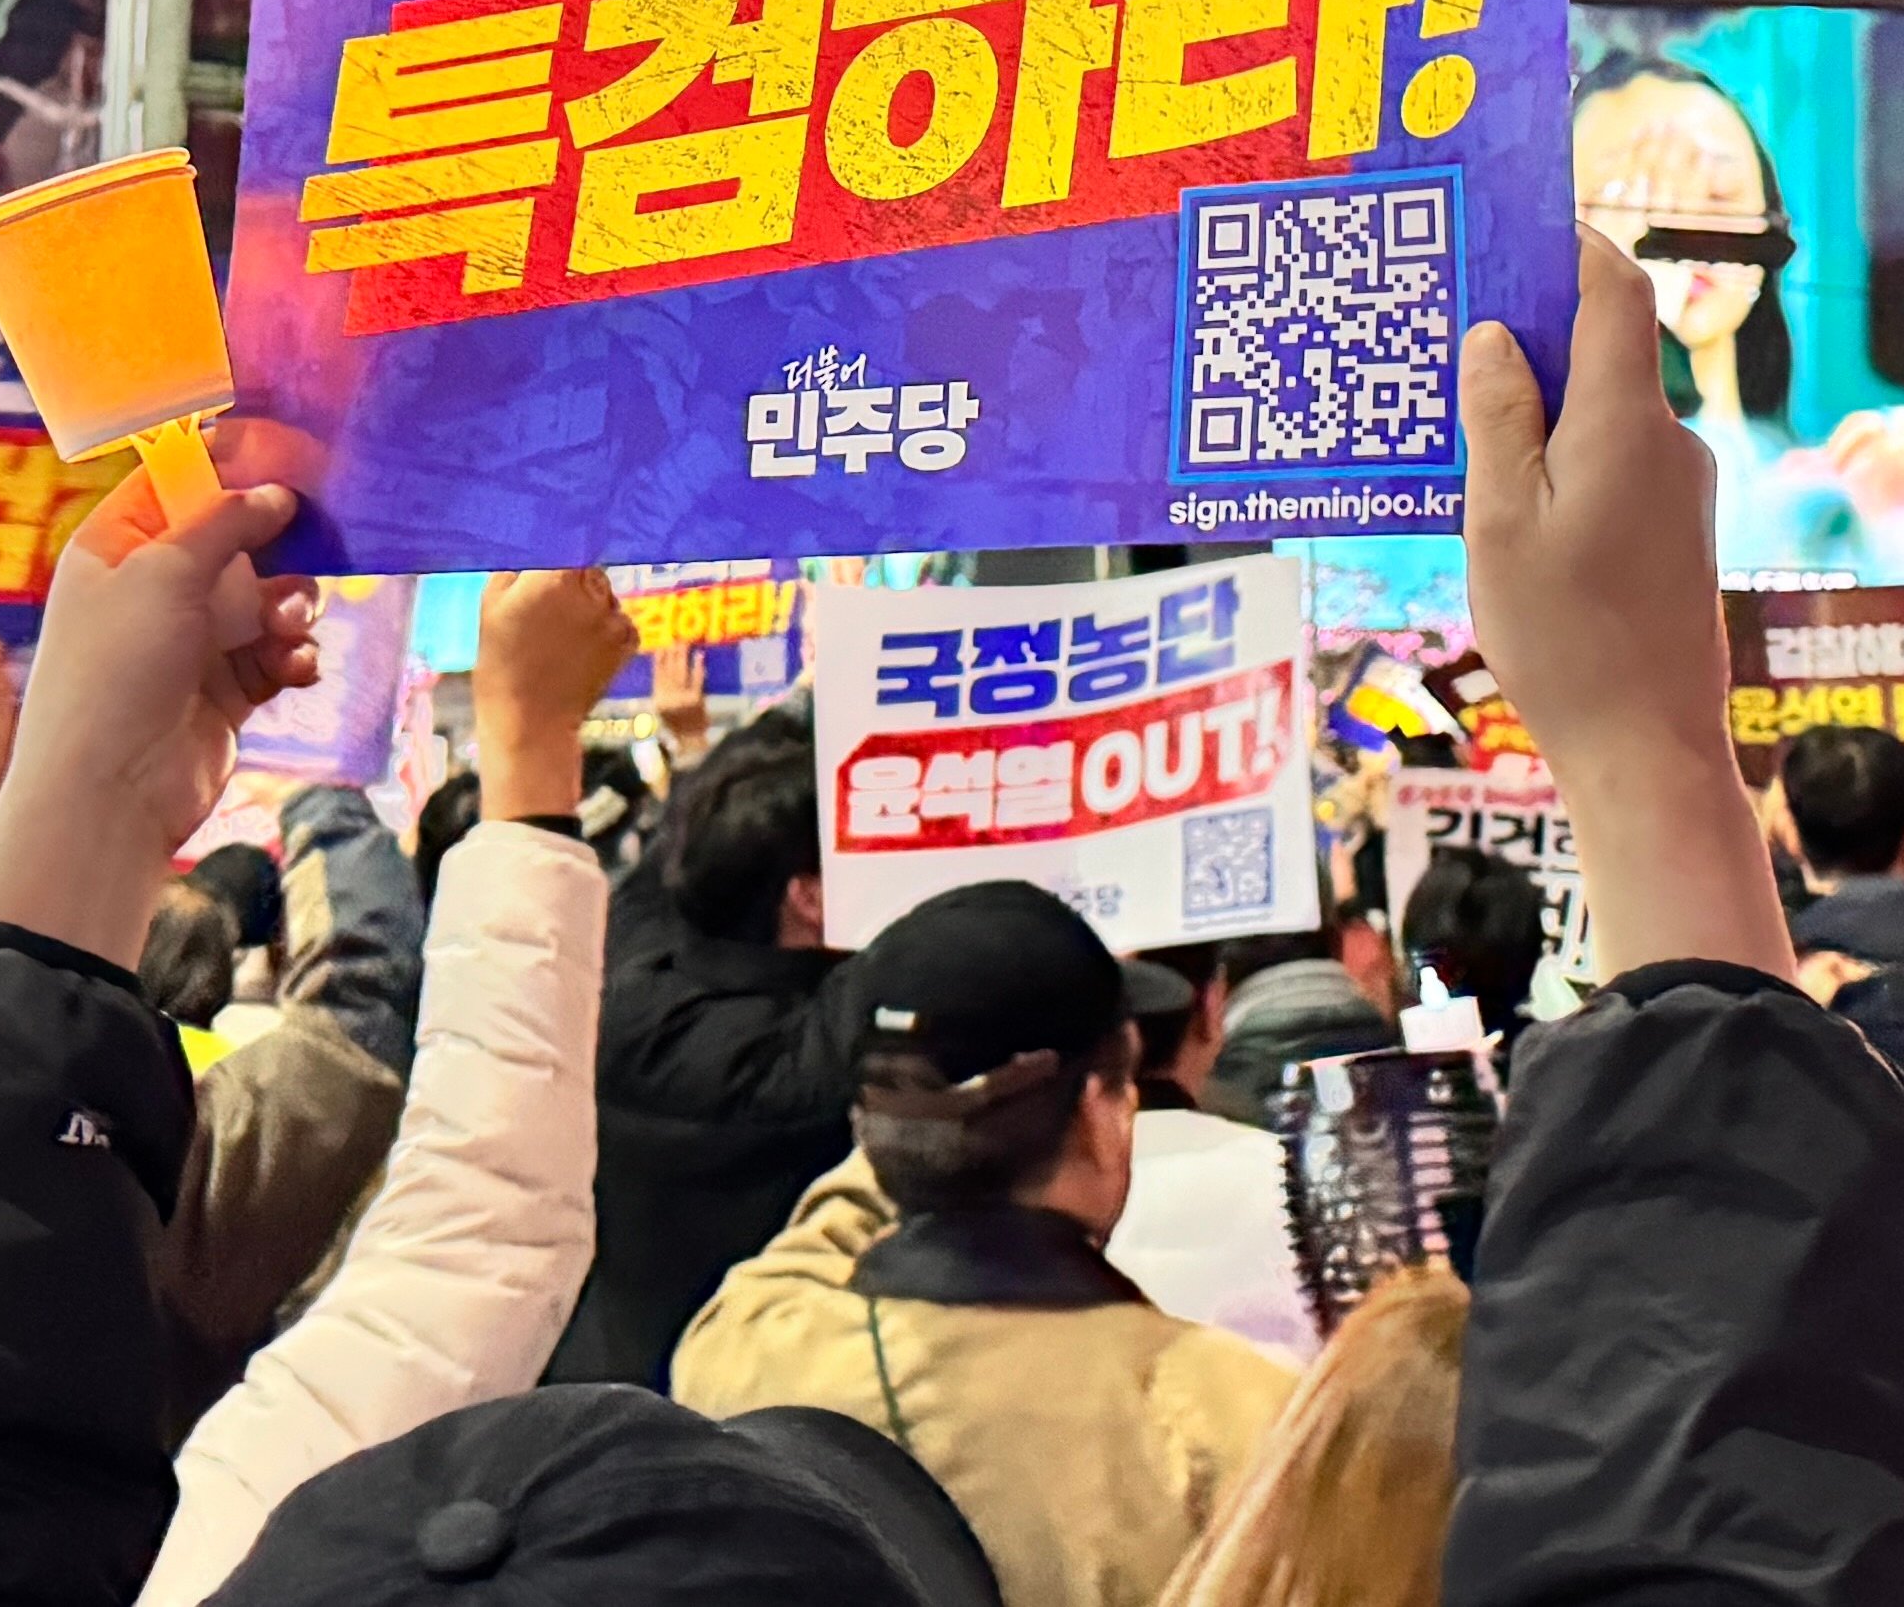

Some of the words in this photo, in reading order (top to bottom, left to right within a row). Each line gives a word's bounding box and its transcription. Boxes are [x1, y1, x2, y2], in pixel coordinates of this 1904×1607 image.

[782, 344, 867, 393] 더불어
[747, 381, 981, 478] 민주당
[1168, 485, 1464, 532] sign.theminjoo.kr
[620, 578, 797, 651] 검하라!
[876, 574, 1240, 718] 국정농단
[848, 739, 1076, 837] 윤석열
[1081, 686, 1282, 814] OUT!
